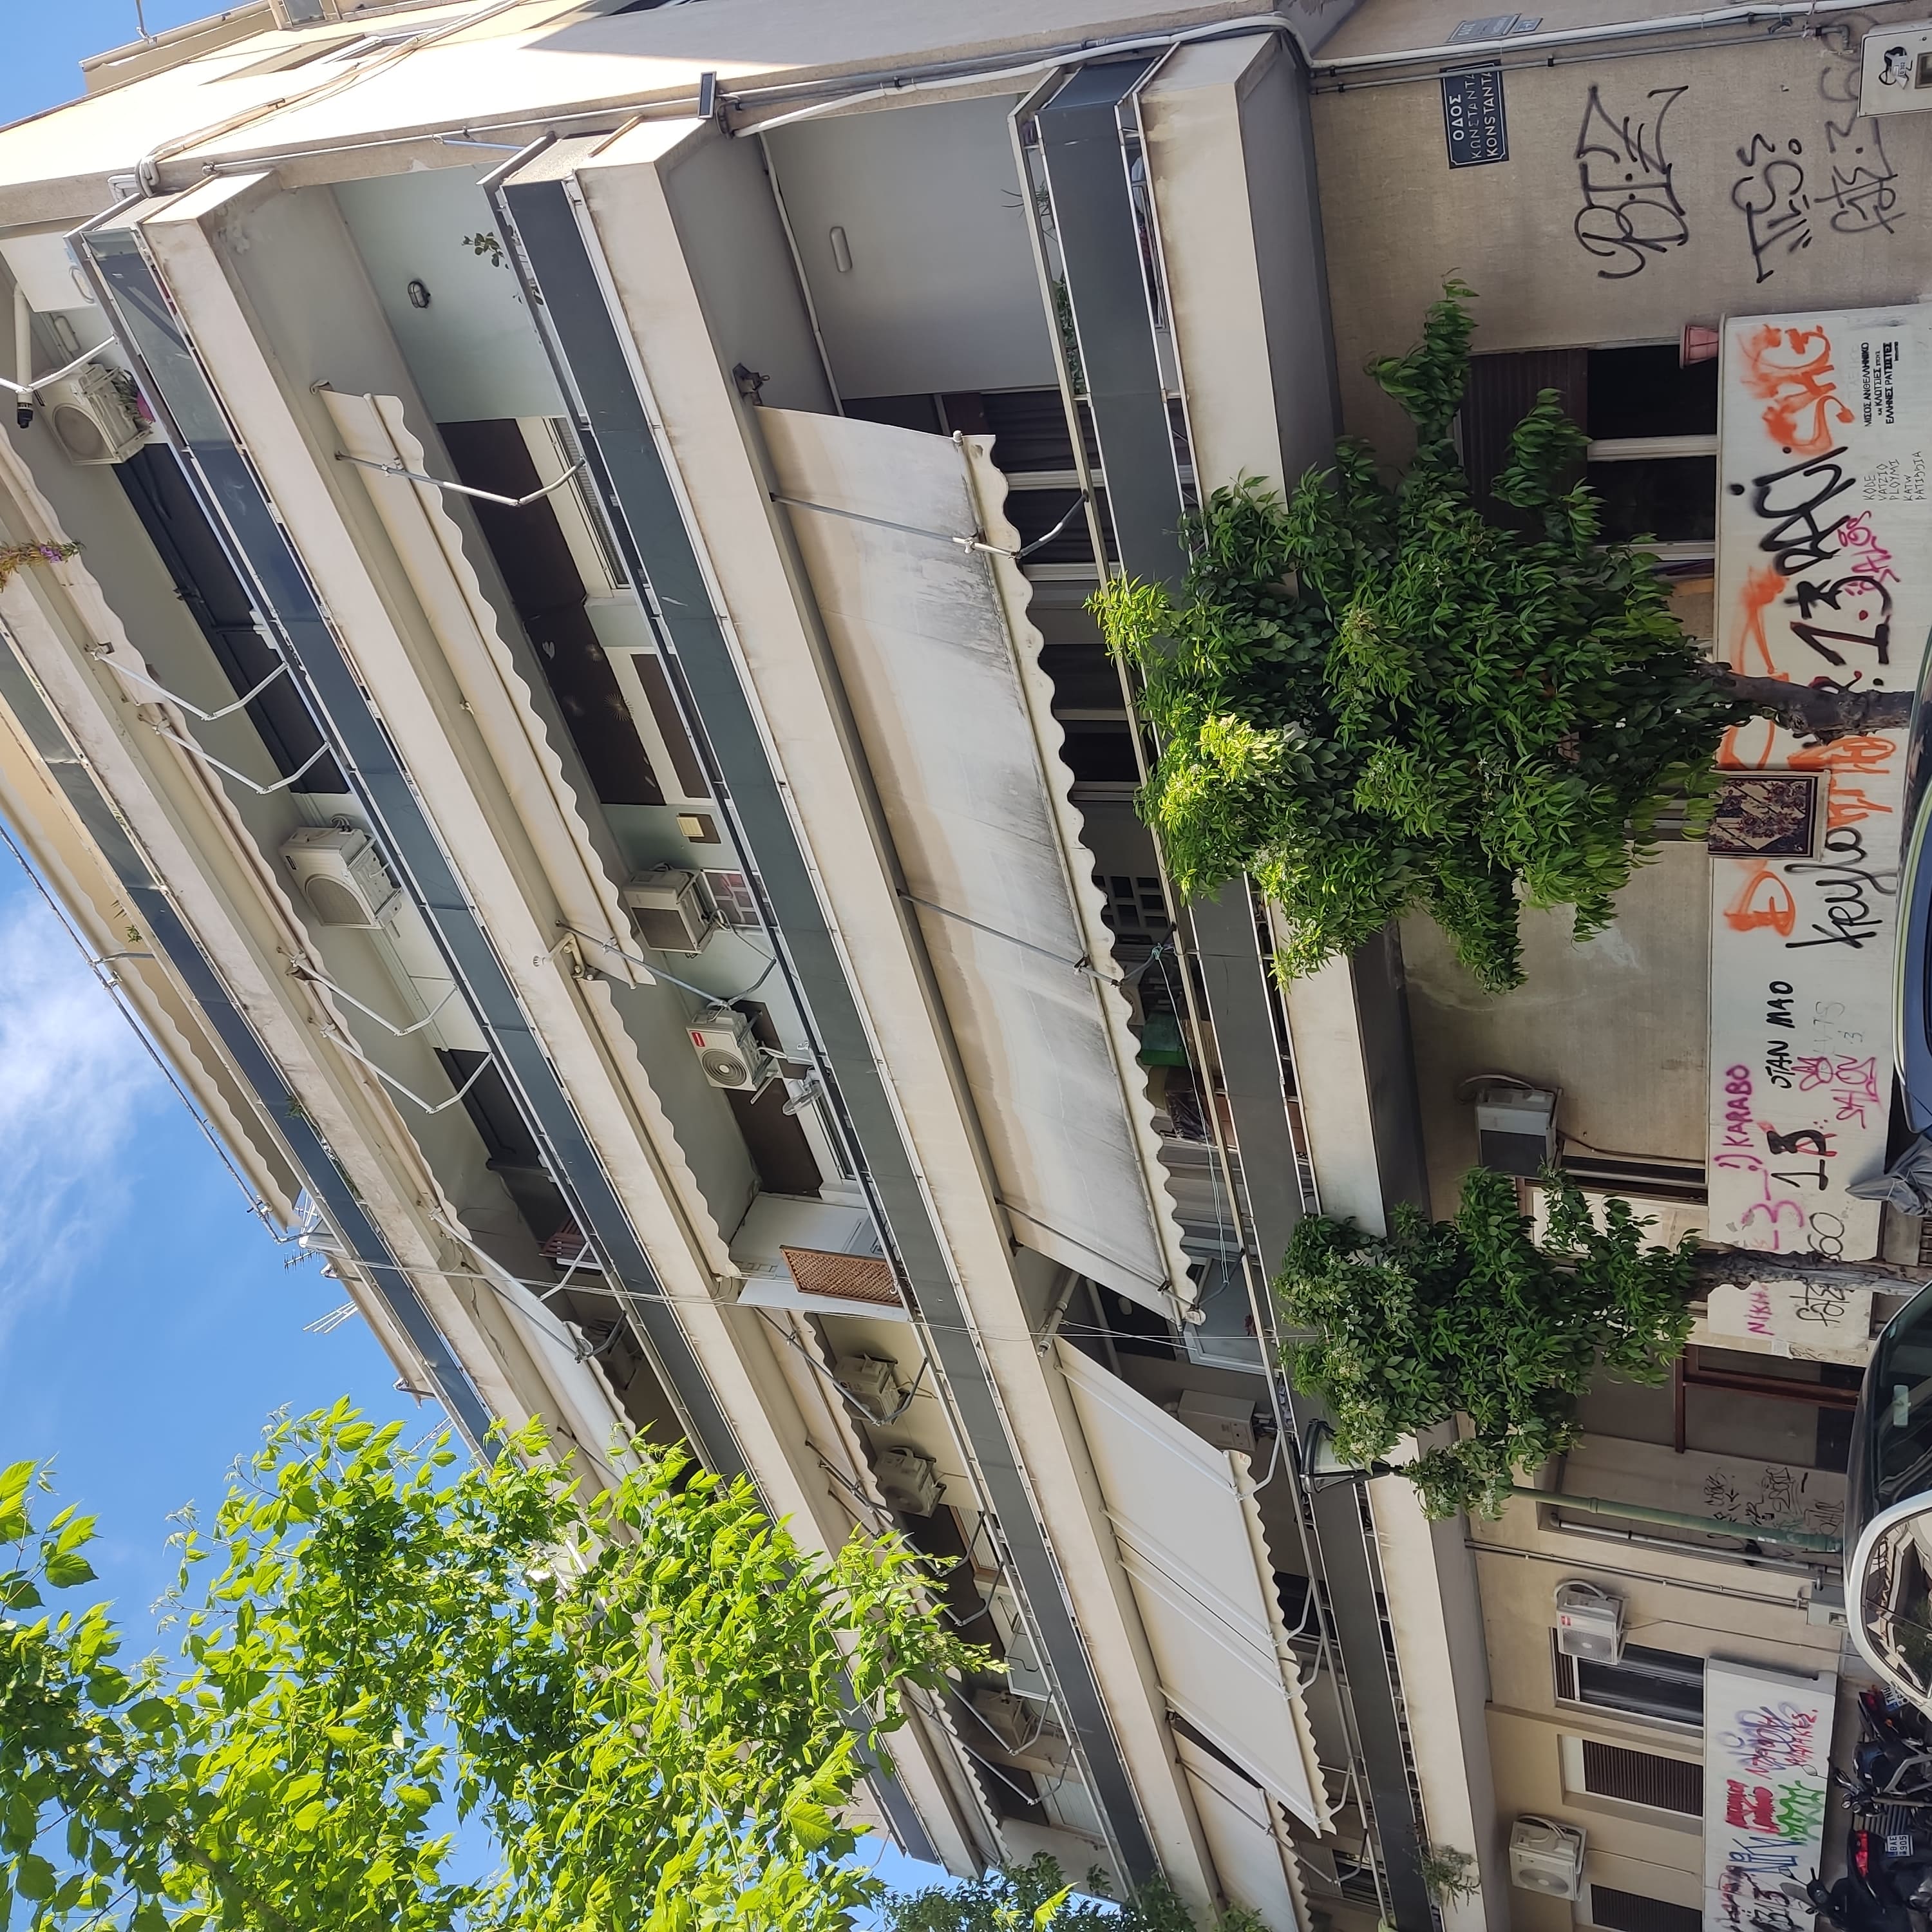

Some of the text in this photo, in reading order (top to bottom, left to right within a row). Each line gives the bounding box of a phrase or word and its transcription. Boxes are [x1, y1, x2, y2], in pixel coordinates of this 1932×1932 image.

[1449, 94, 1464, 140] ΟΔΟΣ
[1863, 402, 1872, 426] ΜΙΣΟΣ
[1885, 386, 1894, 424] ΕΛΛΗΝΕΣ
[1722, 1065, 1754, 1148] KARABO
